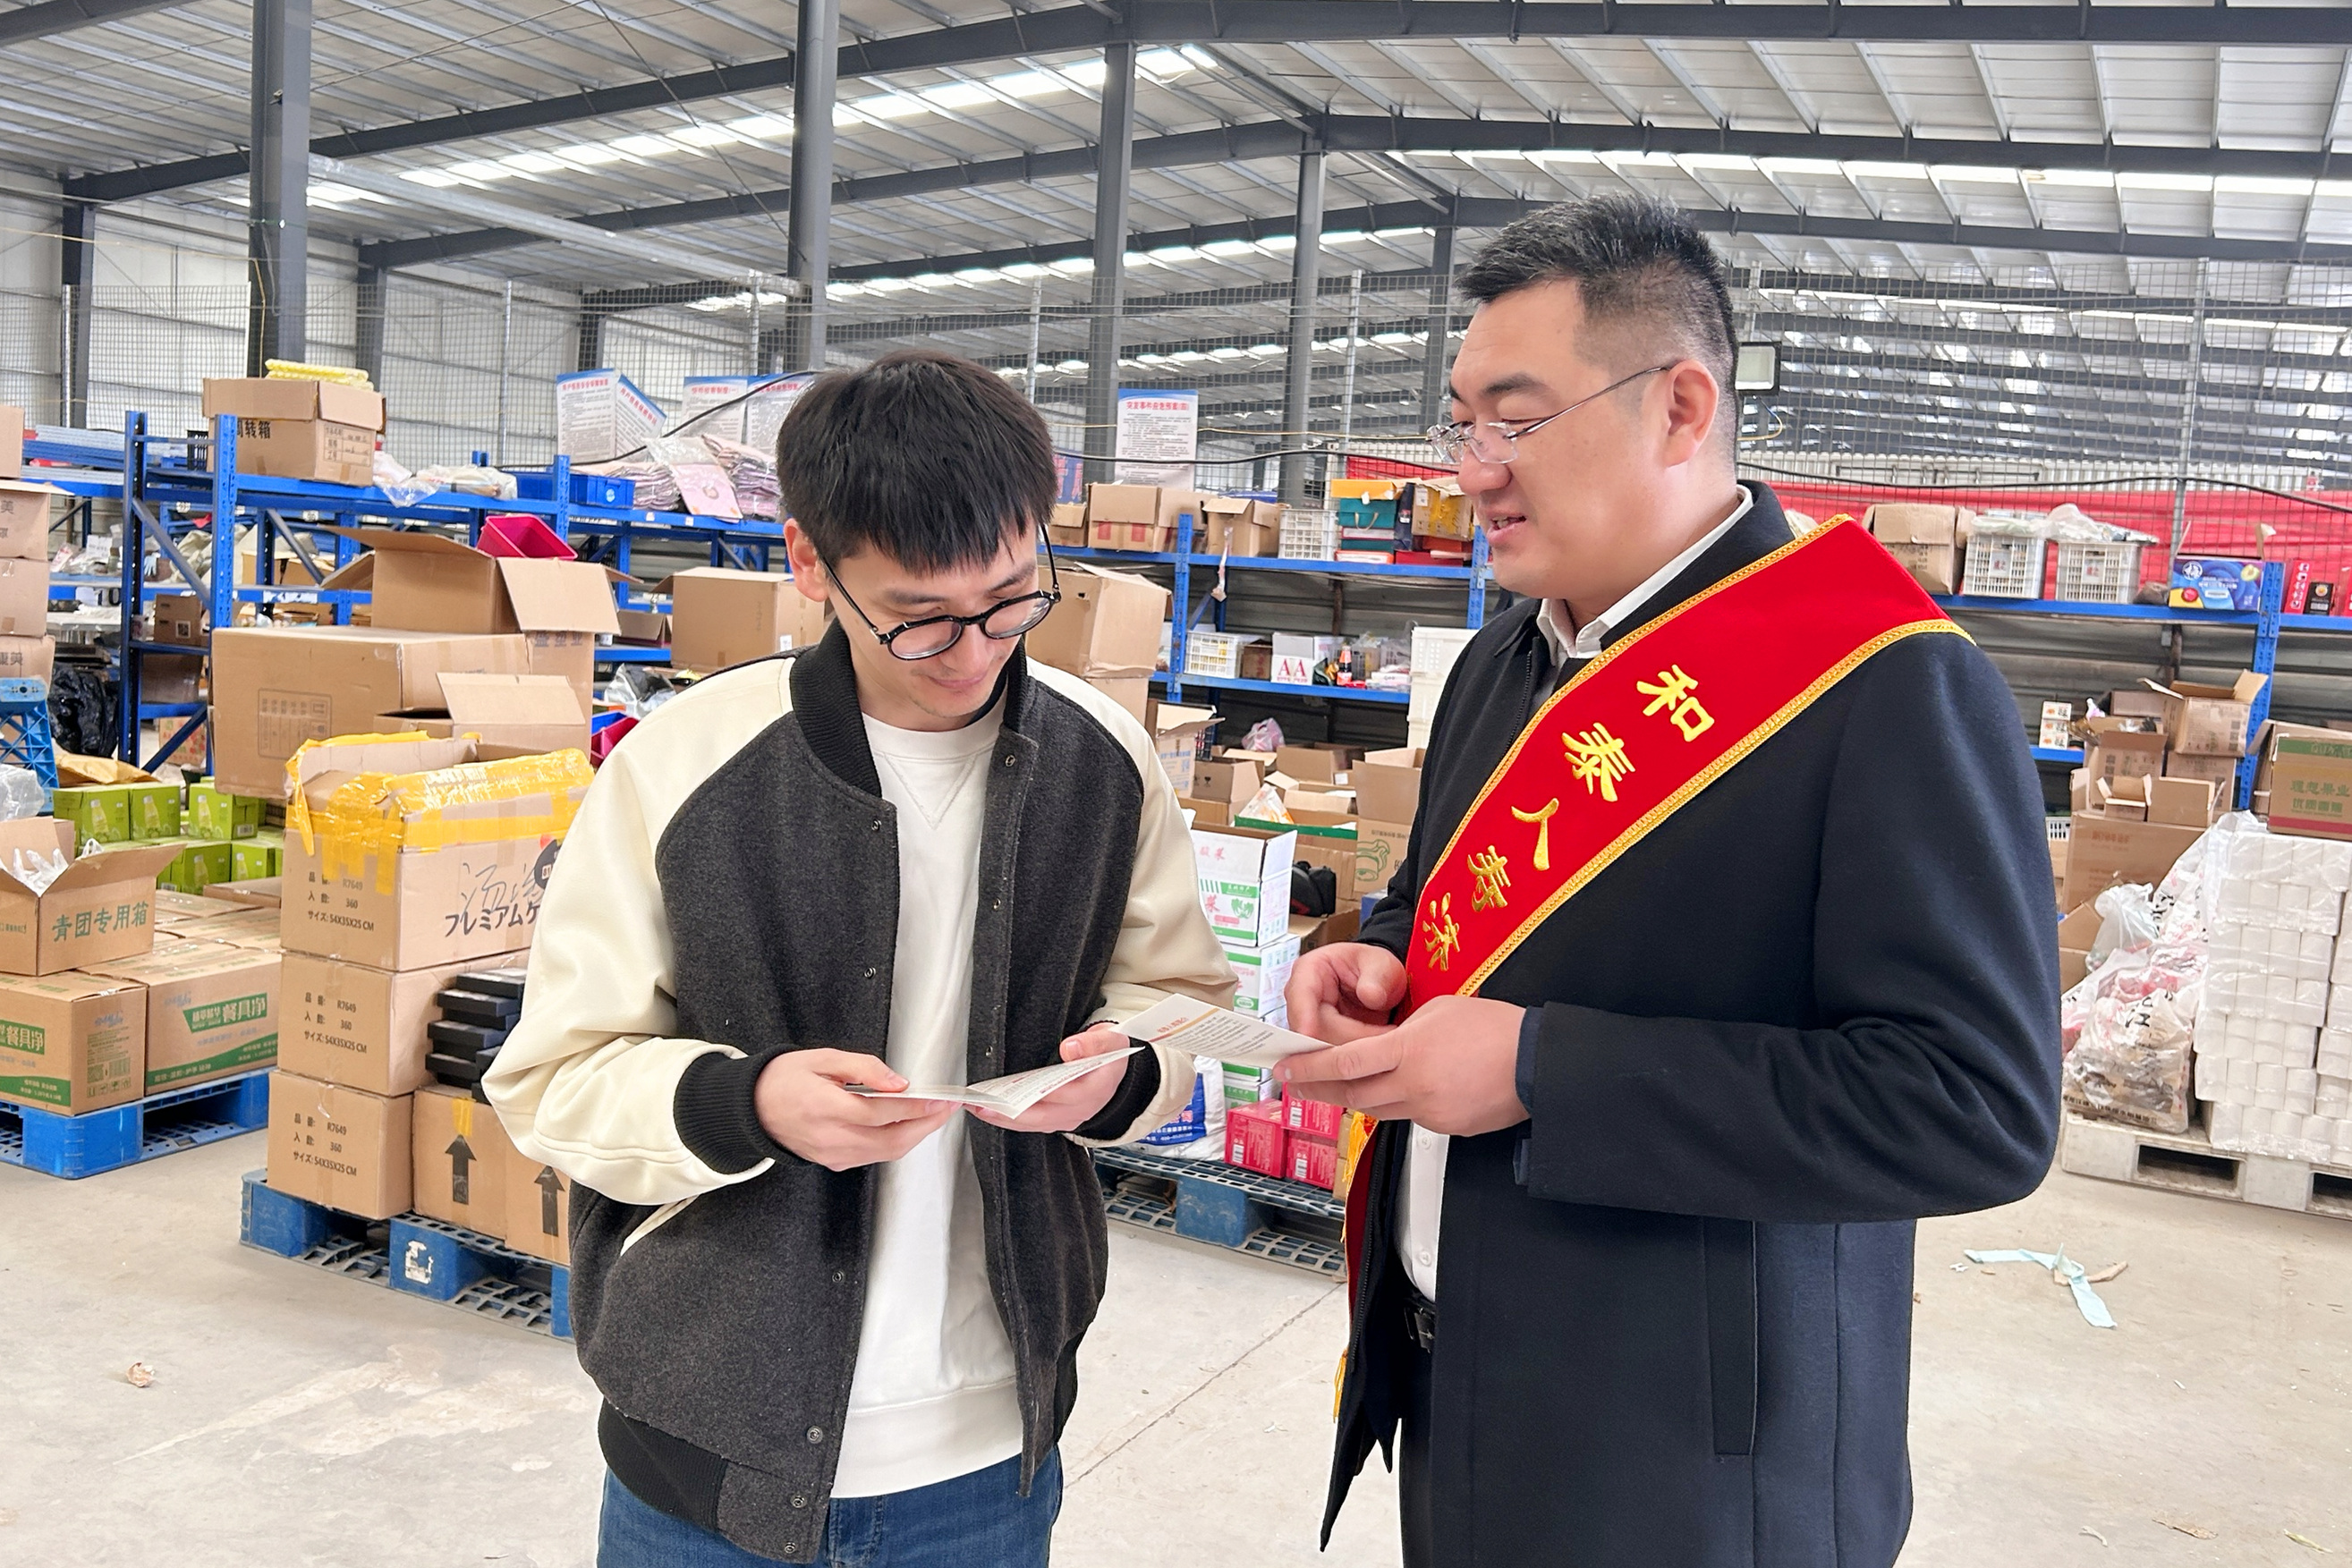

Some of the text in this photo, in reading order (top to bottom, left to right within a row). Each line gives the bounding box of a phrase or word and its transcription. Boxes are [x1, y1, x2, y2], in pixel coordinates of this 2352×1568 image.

[343, 877, 363, 891] R7649
[345, 898, 359, 909] 360
[52, 901, 149, 943] 青团专用箱
[329, 914, 362, 929] 54X35X25
[362, 920, 374, 931] CM
[222, 997, 266, 1023] 餐具净
[336, 999, 357, 1013] R7649
[340, 1020, 352, 1030] 360
[6, 1025, 44, 1051] 餐具净
[325, 1035, 355, 1051] 54X35X25
[356, 1043, 368, 1054] CM
[327, 1122, 347, 1135] R7649
[329, 1141, 342, 1153] 360
[314, 1157, 345, 1174] 54X35X25
[345, 1165, 357, 1176] CM
